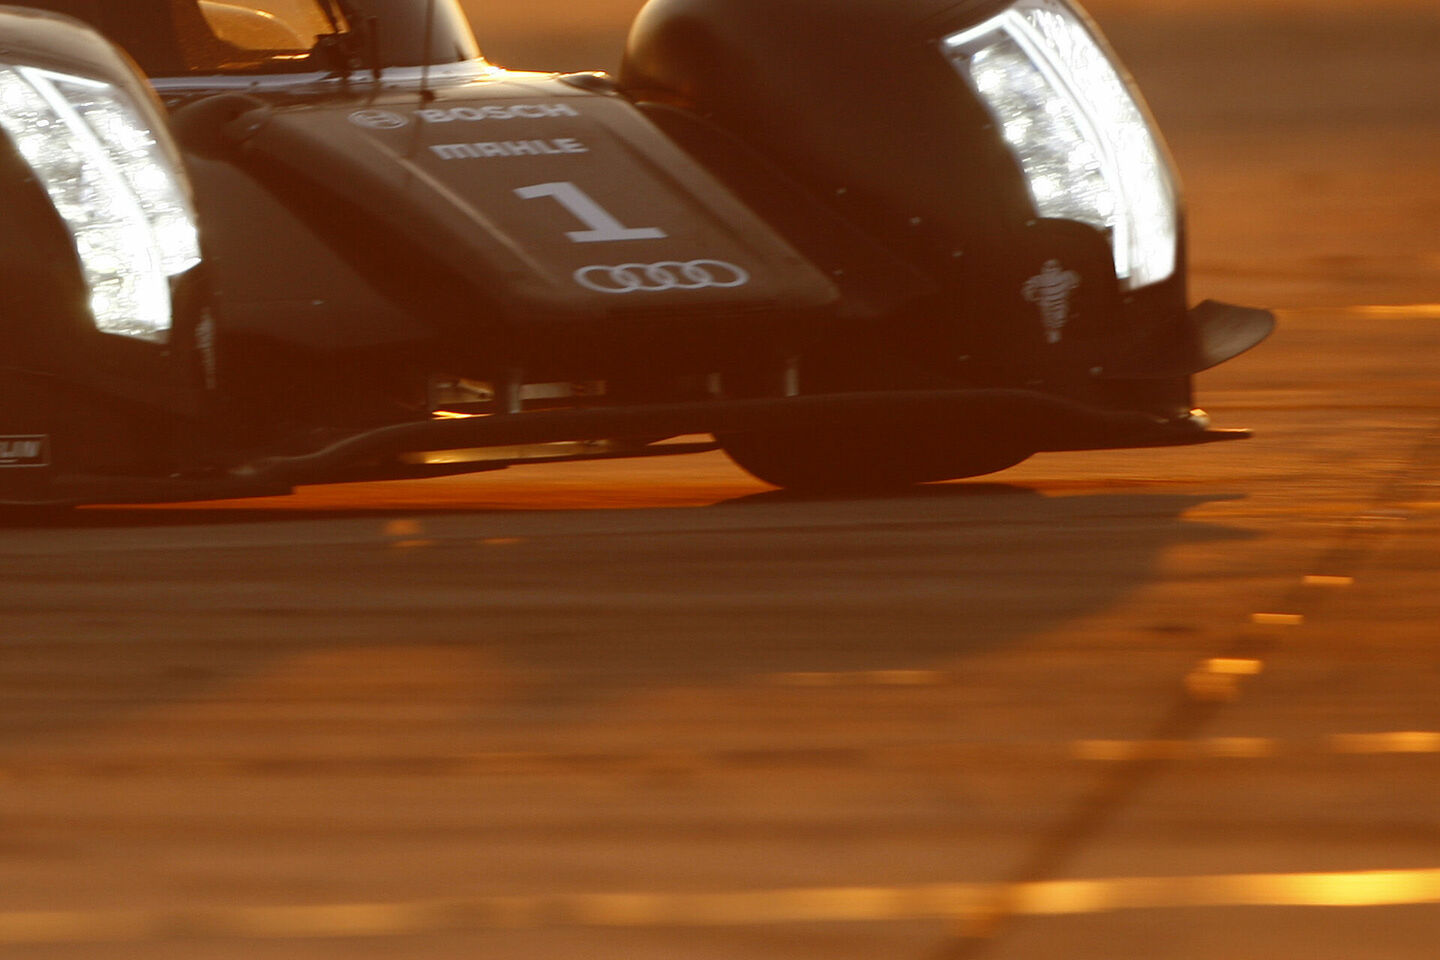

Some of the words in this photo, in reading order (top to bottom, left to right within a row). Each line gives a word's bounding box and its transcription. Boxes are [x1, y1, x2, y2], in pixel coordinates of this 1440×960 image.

[414, 104, 581, 123] BOSCH
[428, 138, 590, 160] MAHLE
[512, 181, 668, 243] 1
